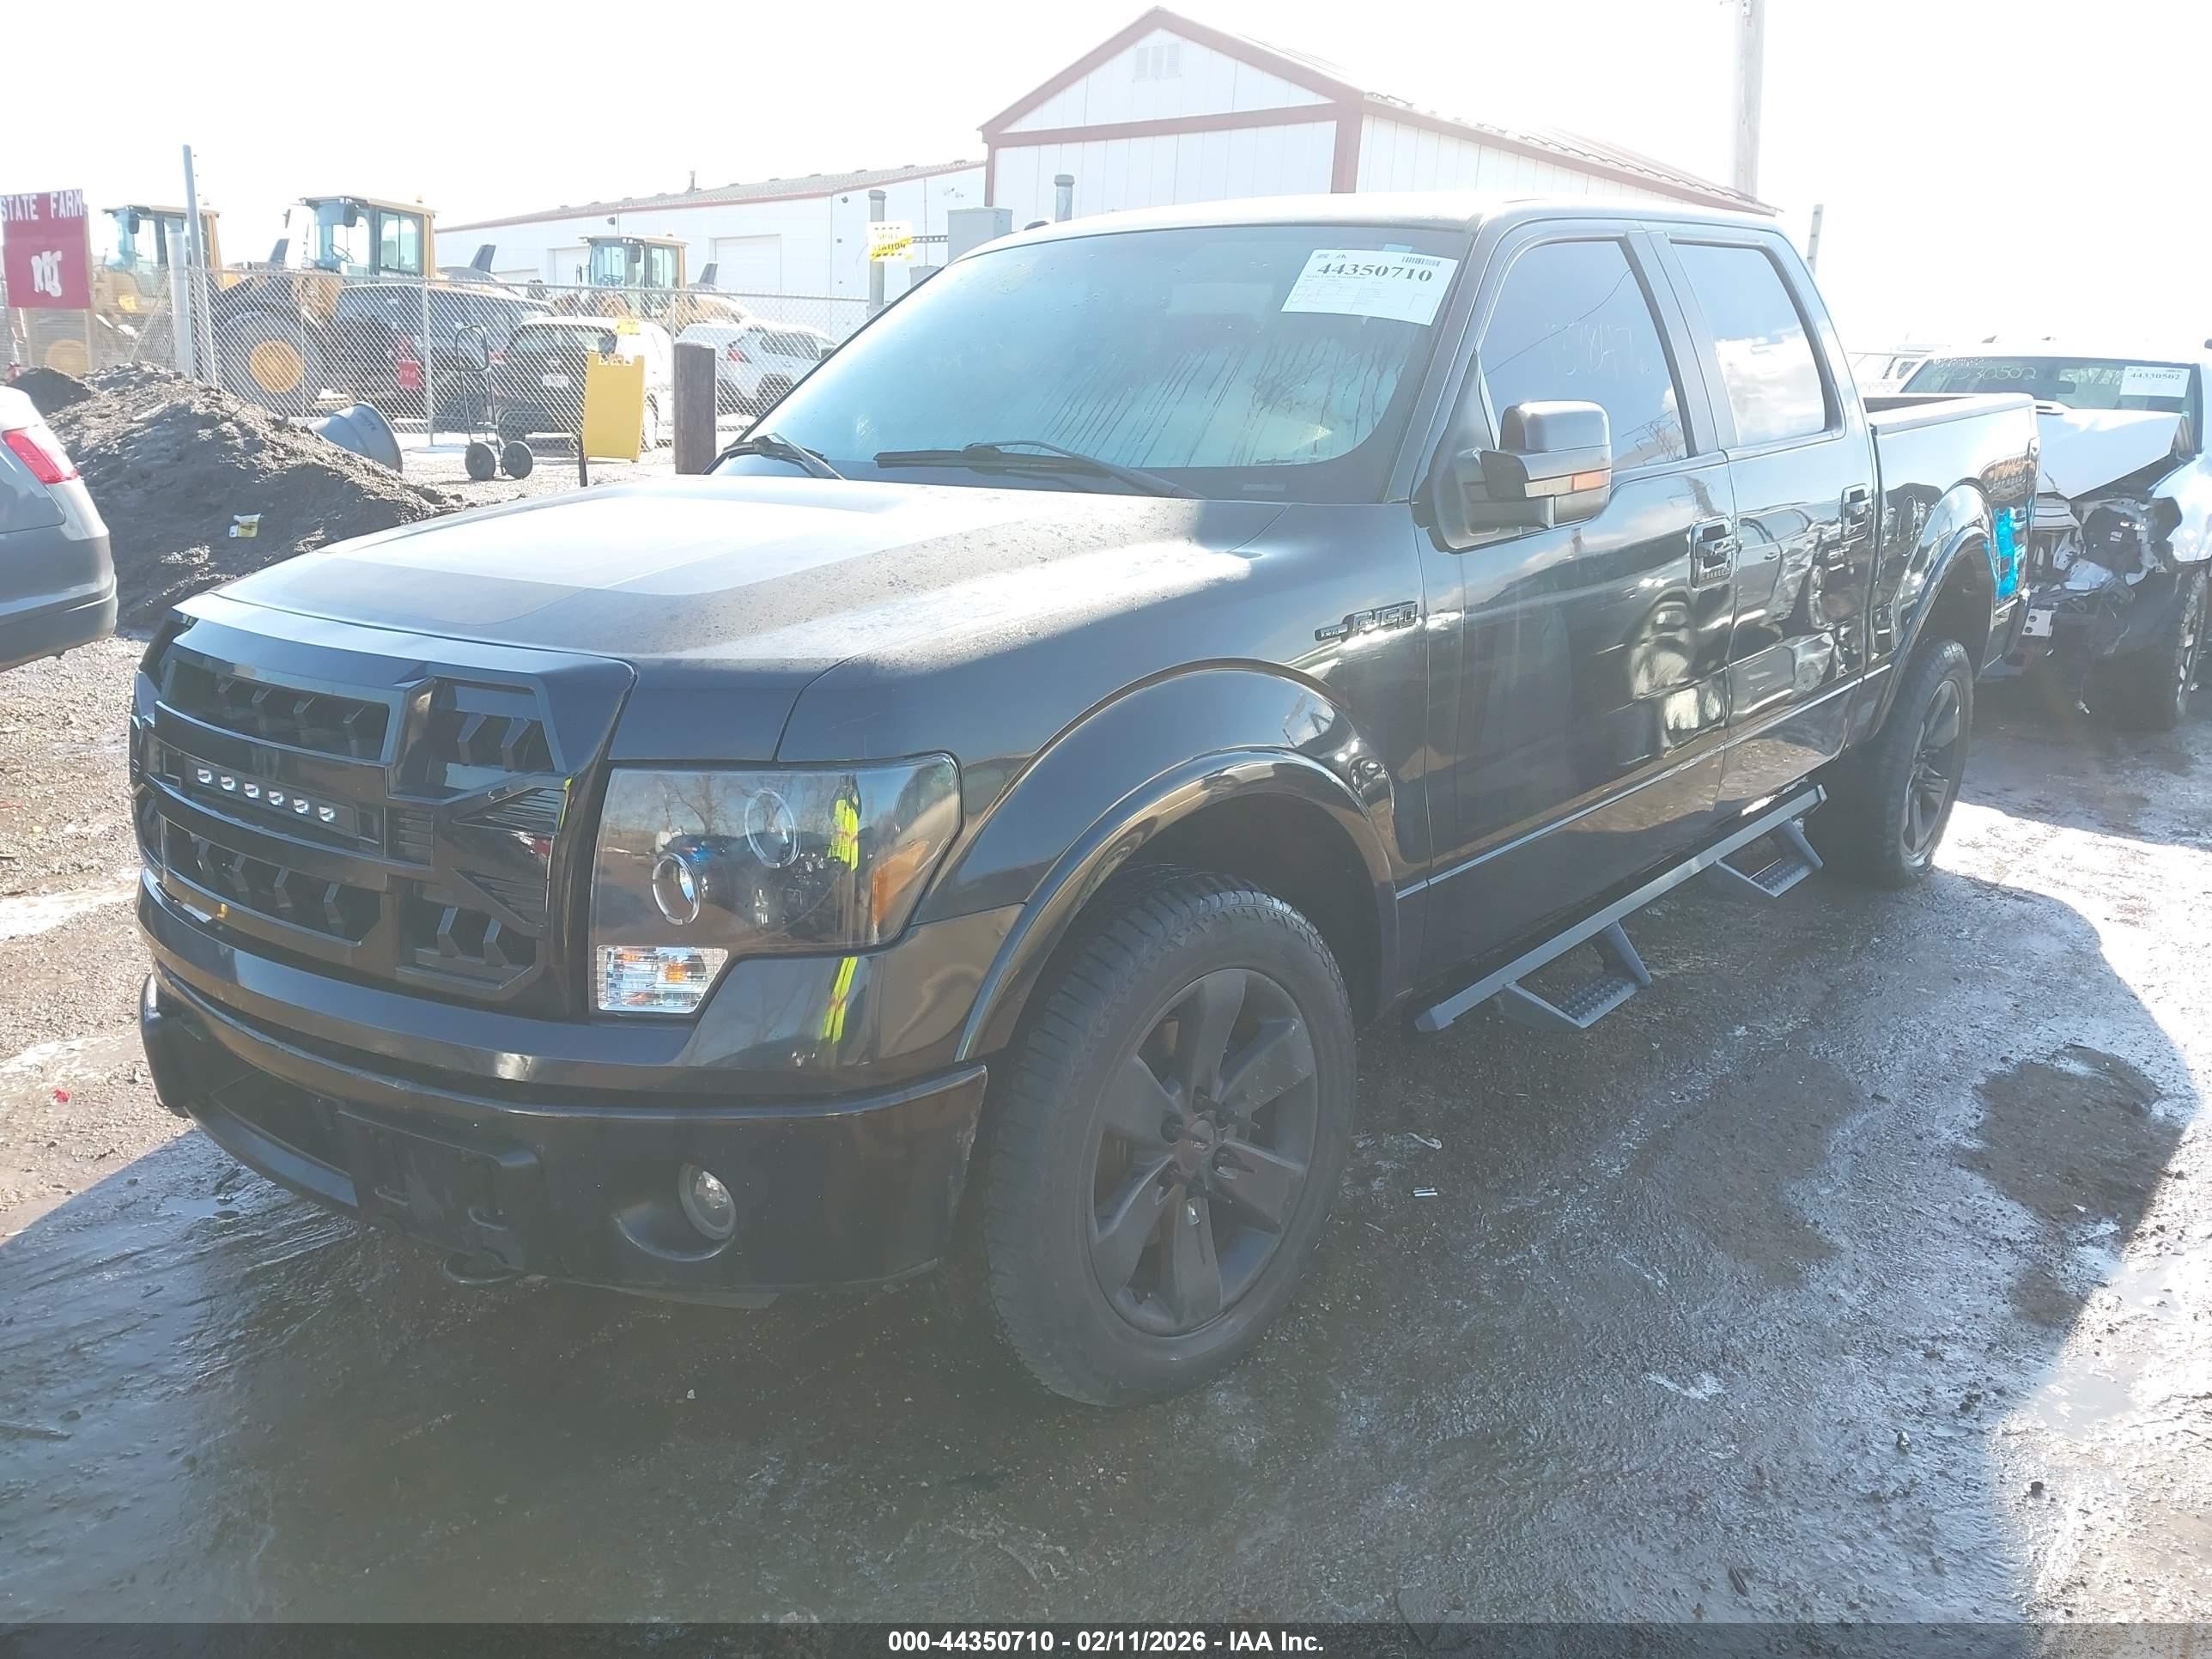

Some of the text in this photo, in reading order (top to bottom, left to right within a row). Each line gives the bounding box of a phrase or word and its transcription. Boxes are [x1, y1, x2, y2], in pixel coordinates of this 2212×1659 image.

[0, 188, 83, 222] STATE FARM
[1316, 262, 1432, 282] 44350710
